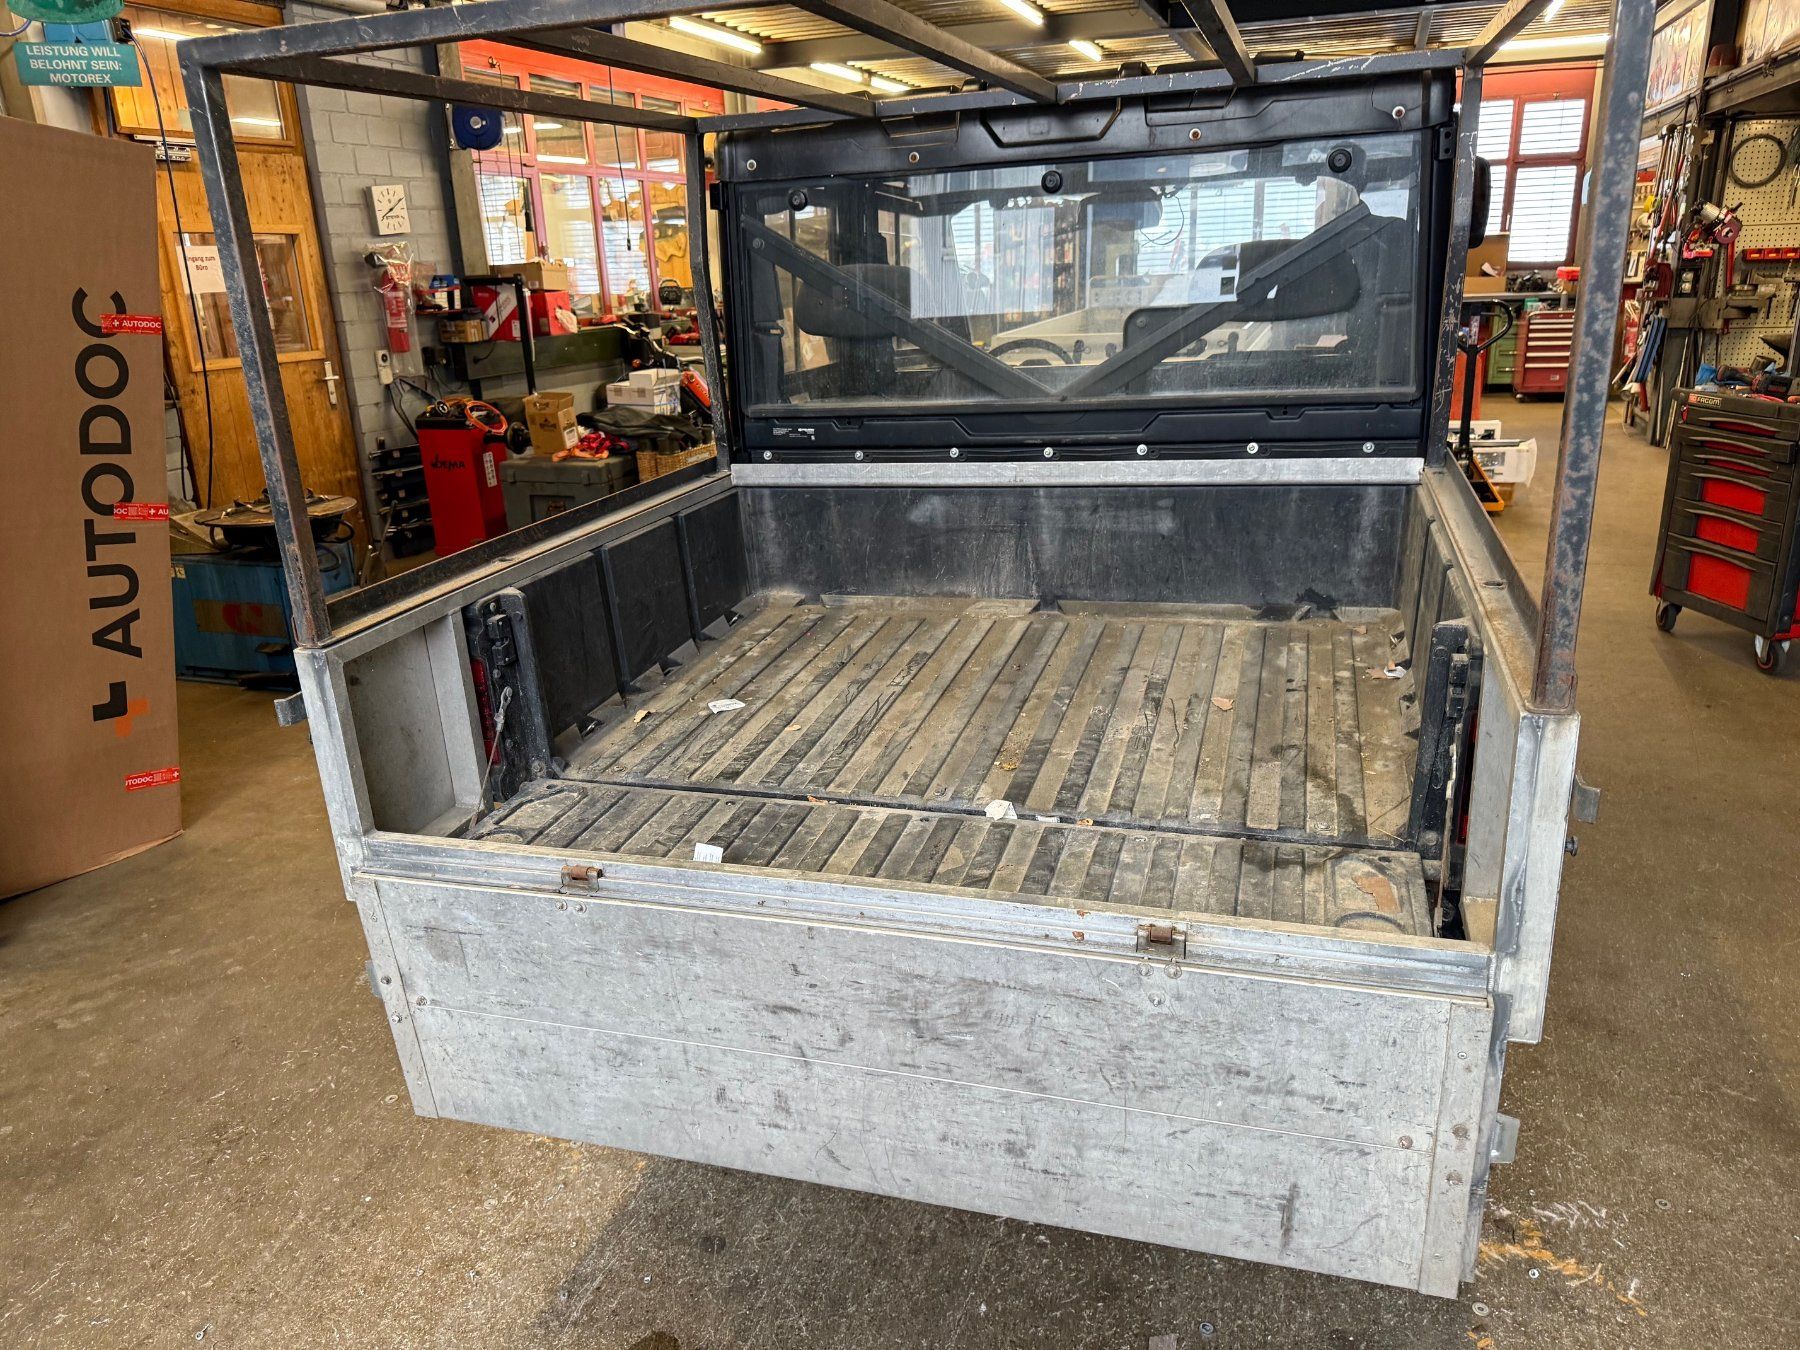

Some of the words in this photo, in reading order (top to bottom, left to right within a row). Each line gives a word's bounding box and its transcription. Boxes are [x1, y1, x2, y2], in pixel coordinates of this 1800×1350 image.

[26, 45, 88, 56] LEISTUNG
[91, 47, 121, 57] WILL
[30, 59, 87, 70] BELOHNT
[91, 60, 122, 70] SEIN:
[49, 73, 112, 84] MOTOREX
[121, 320, 161, 329] AUTODOC
[71, 287, 143, 659] AUTODOC
